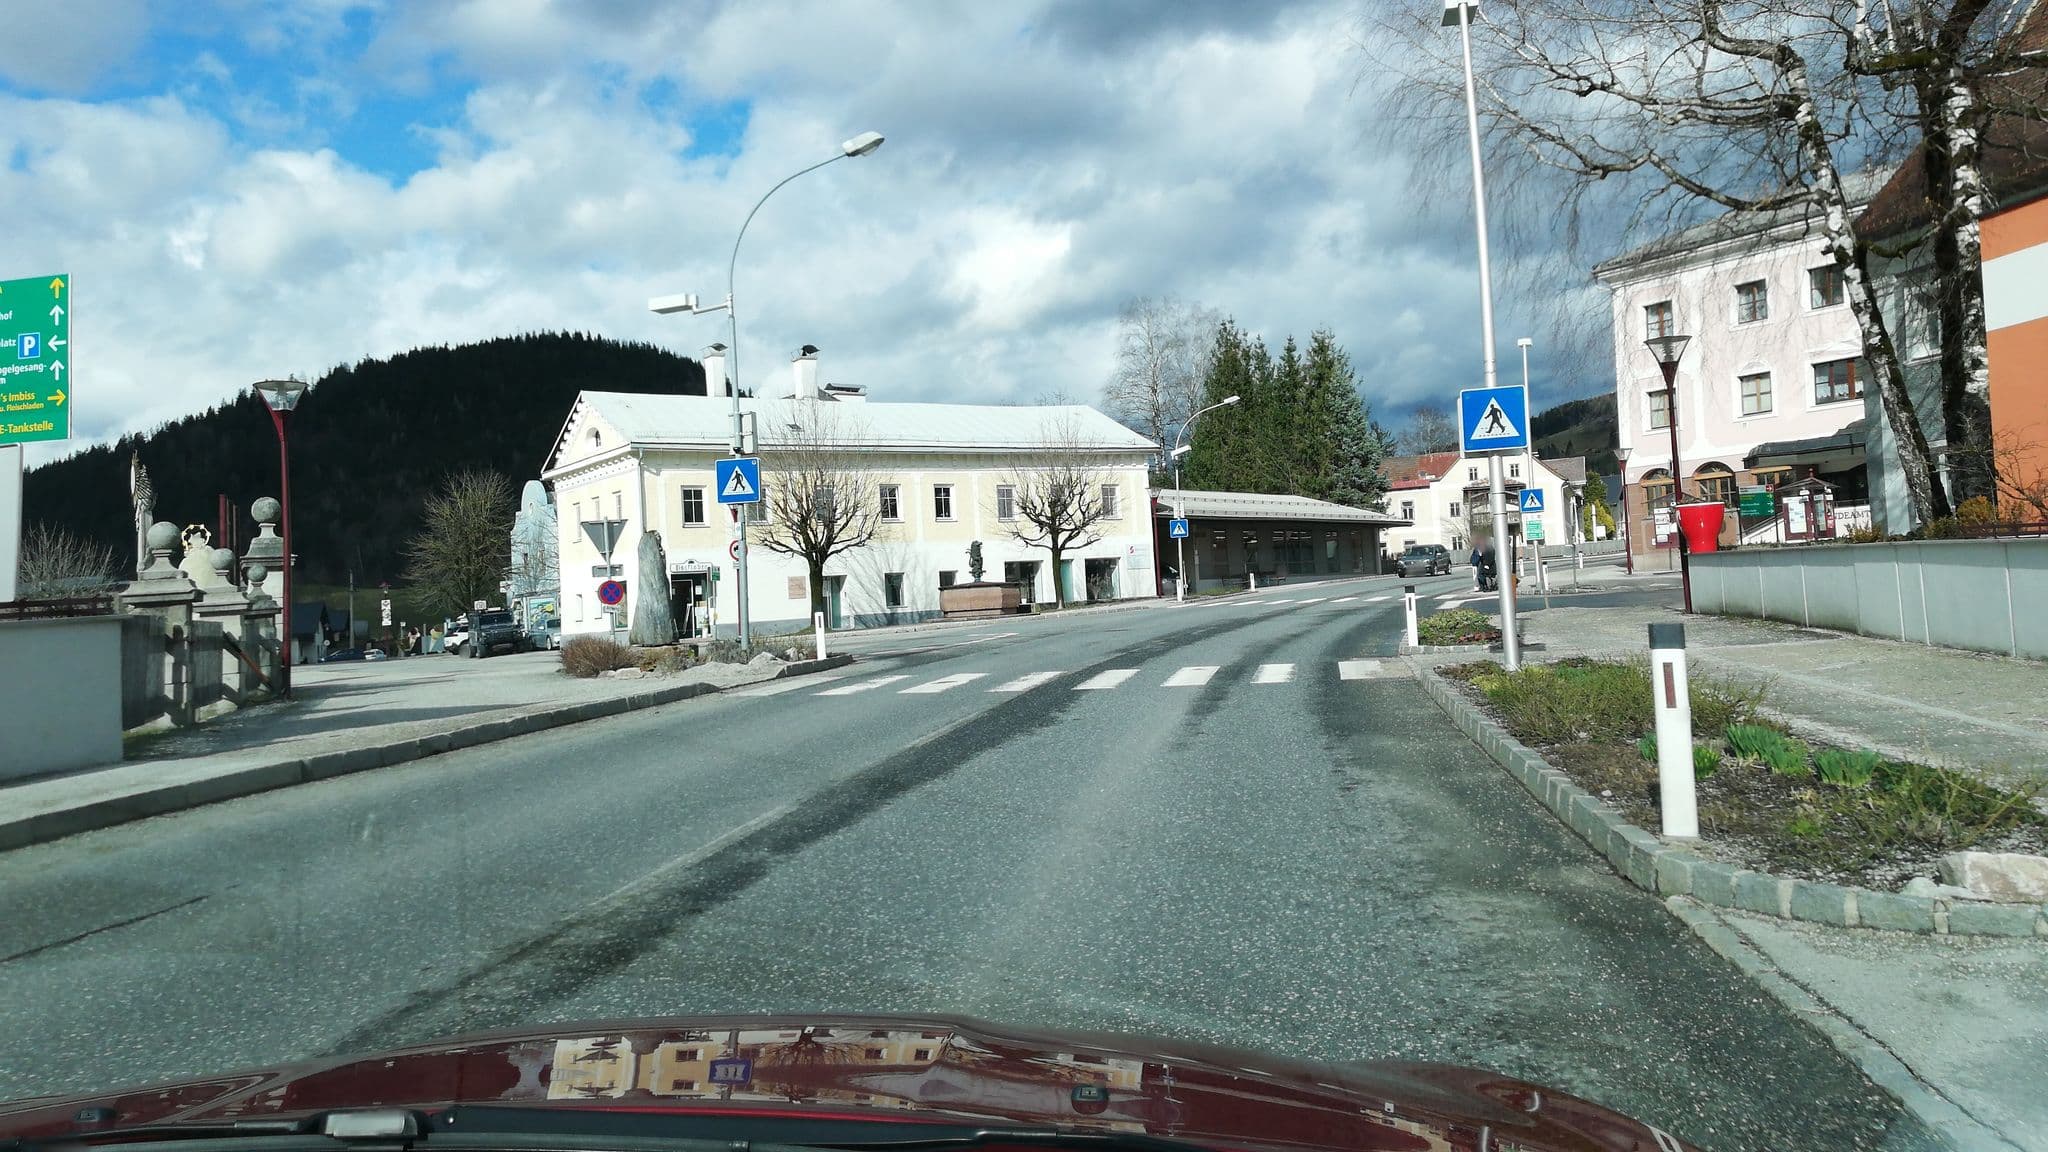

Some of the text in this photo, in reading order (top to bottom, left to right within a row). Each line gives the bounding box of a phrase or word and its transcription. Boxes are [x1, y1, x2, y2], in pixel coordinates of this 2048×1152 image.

[0, 336, 36, 355] latz P
[8, 391, 36, 402] Imbiss
